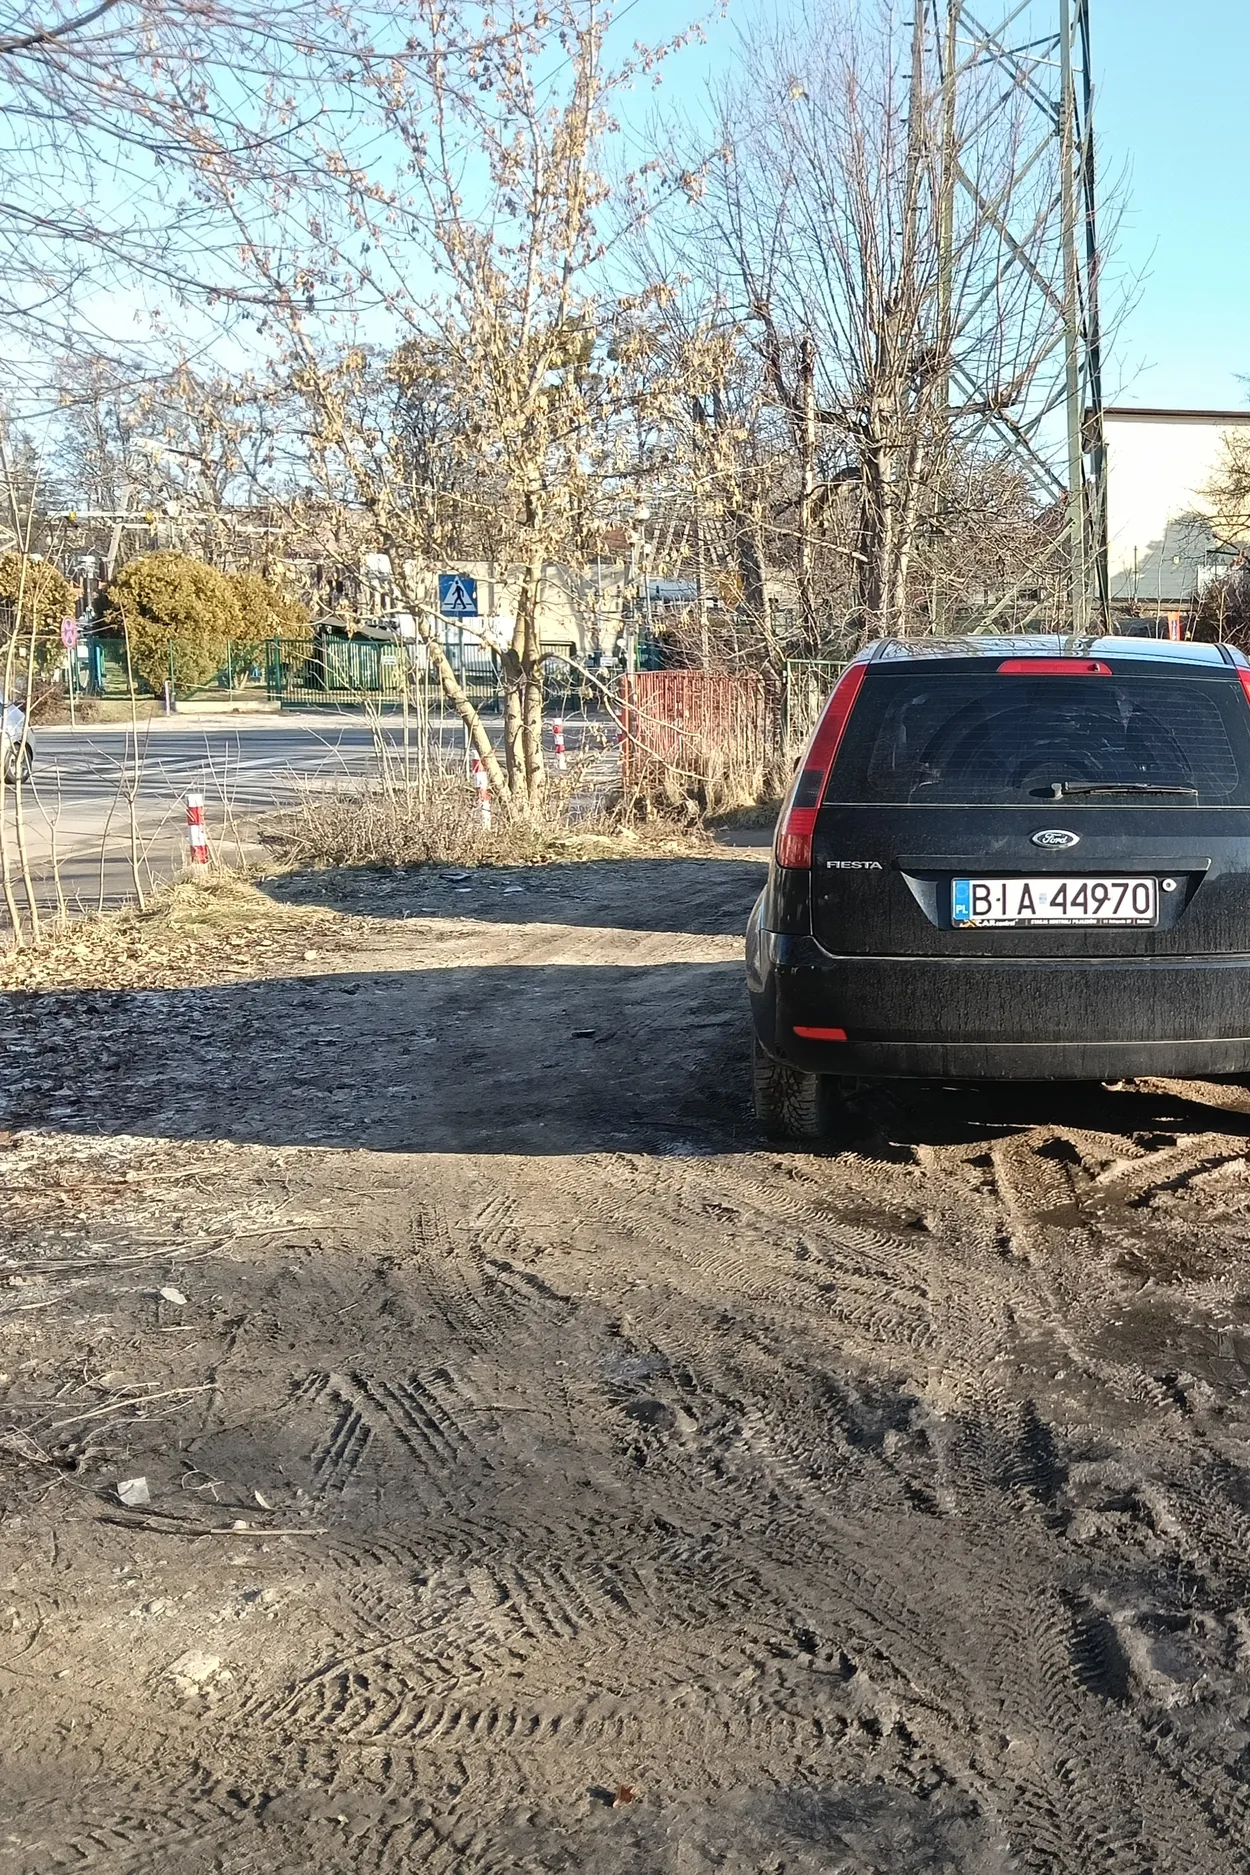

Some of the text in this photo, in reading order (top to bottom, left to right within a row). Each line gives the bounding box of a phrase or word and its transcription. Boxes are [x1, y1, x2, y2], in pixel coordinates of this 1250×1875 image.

[826, 860, 883, 870] FIESTA
[972, 882, 1150, 916] BIA 44970
[956, 905, 969, 914] PL
